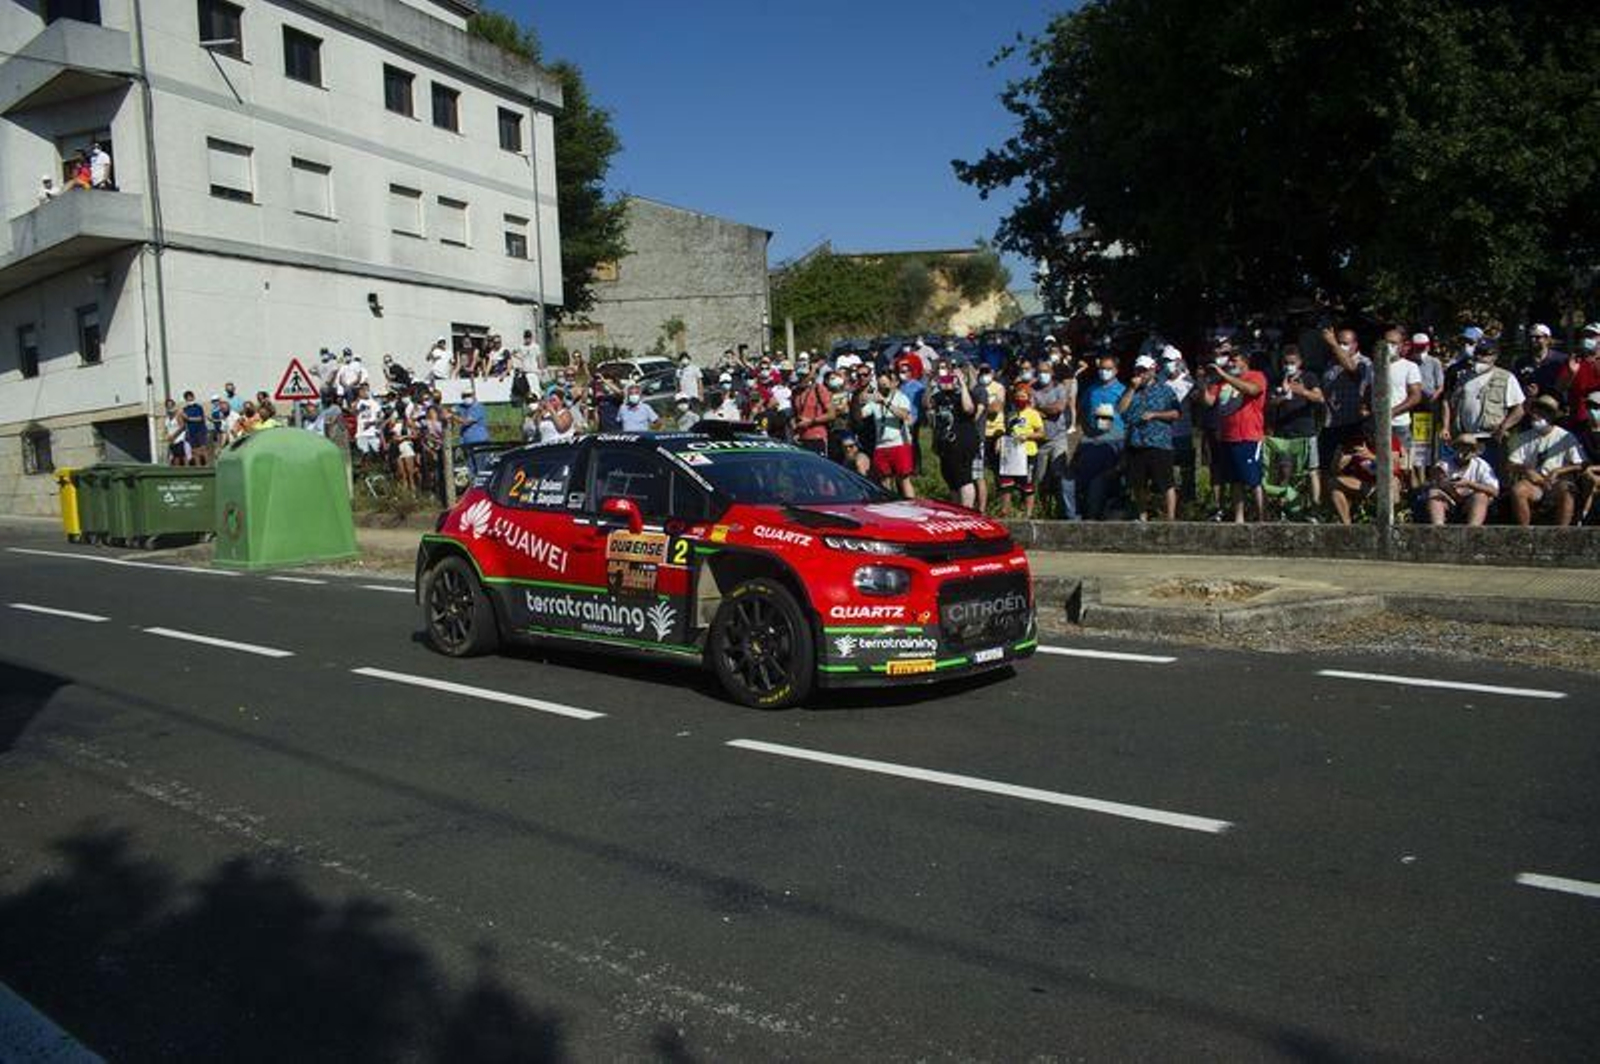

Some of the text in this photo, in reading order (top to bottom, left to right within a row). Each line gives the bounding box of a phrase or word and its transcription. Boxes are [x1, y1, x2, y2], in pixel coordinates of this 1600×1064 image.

[509, 470, 526, 497] 2
[753, 525, 813, 546] QUARTZ
[609, 540, 665, 556] OURENSE
[673, 539, 689, 564] 2
[525, 591, 645, 632] terratraining
[830, 605, 905, 619] QUARTZ
